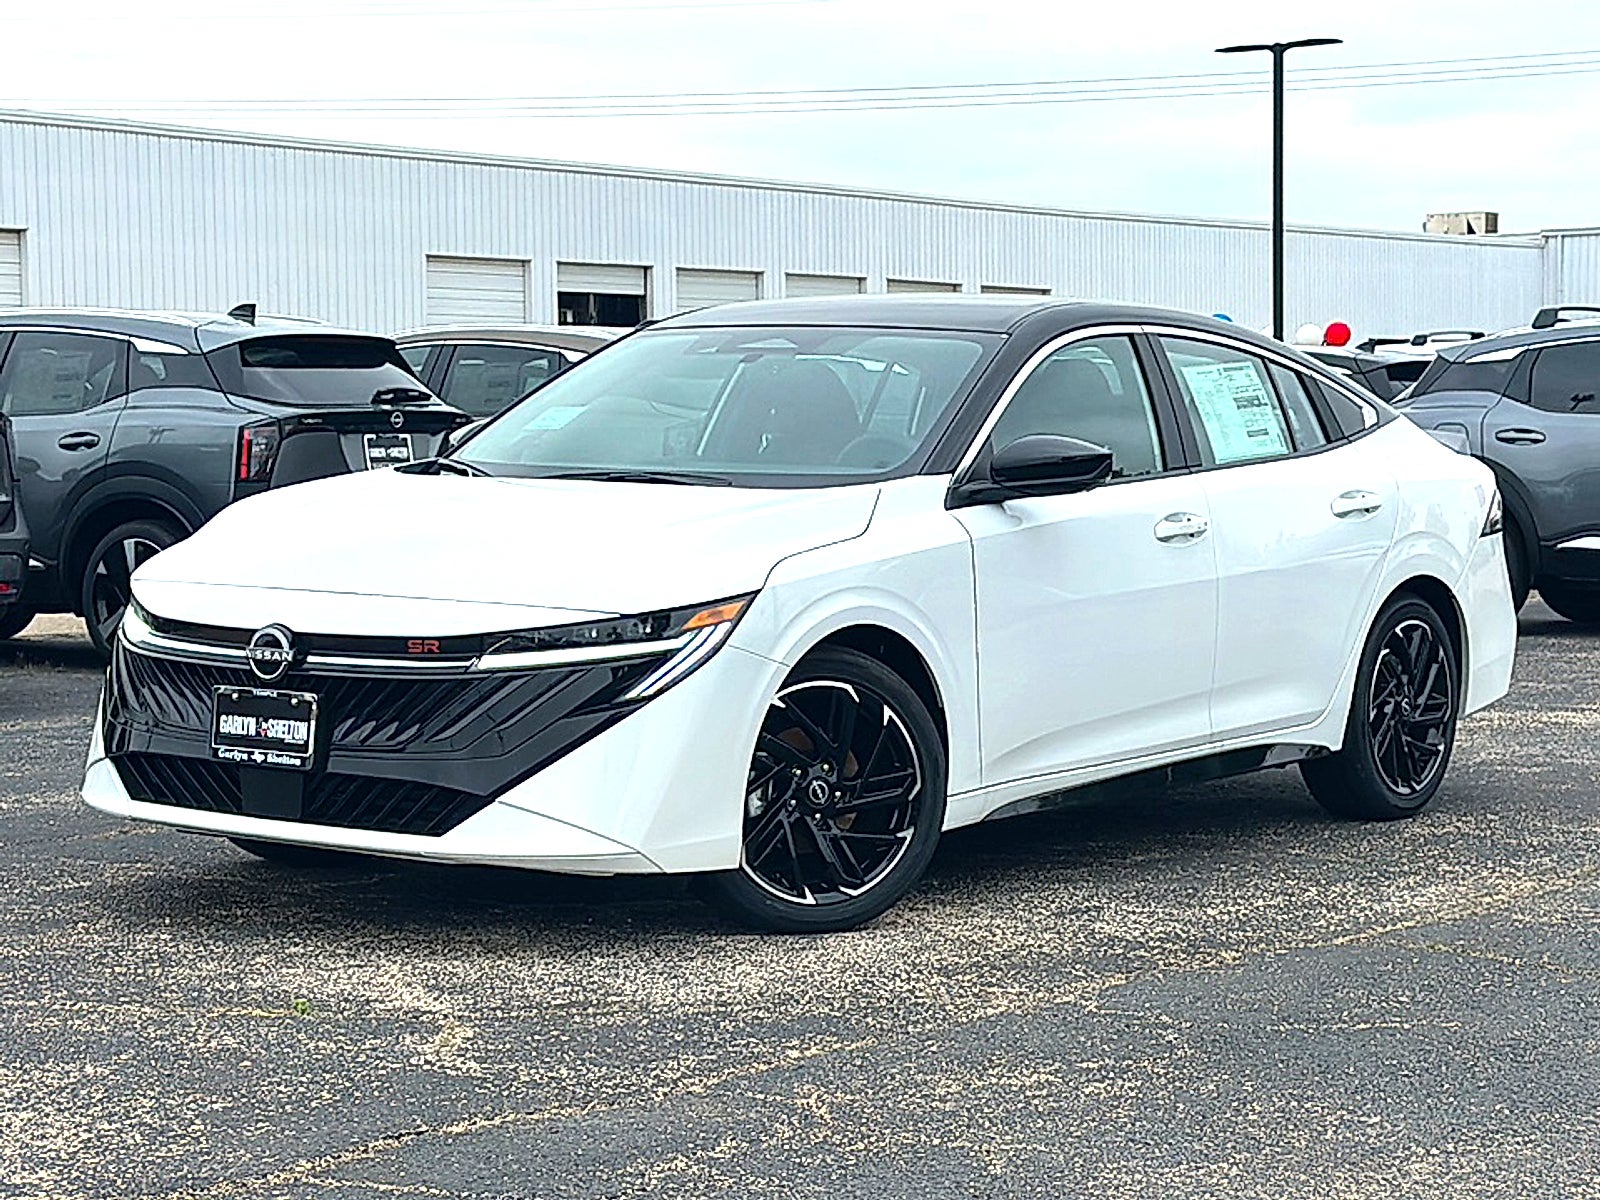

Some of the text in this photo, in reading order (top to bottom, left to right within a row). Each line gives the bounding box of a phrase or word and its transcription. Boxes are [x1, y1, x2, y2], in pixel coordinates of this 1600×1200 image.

[406, 639, 441, 653] SR
[246, 648, 294, 662] NISSAN
[267, 718, 309, 741] SHELTON
